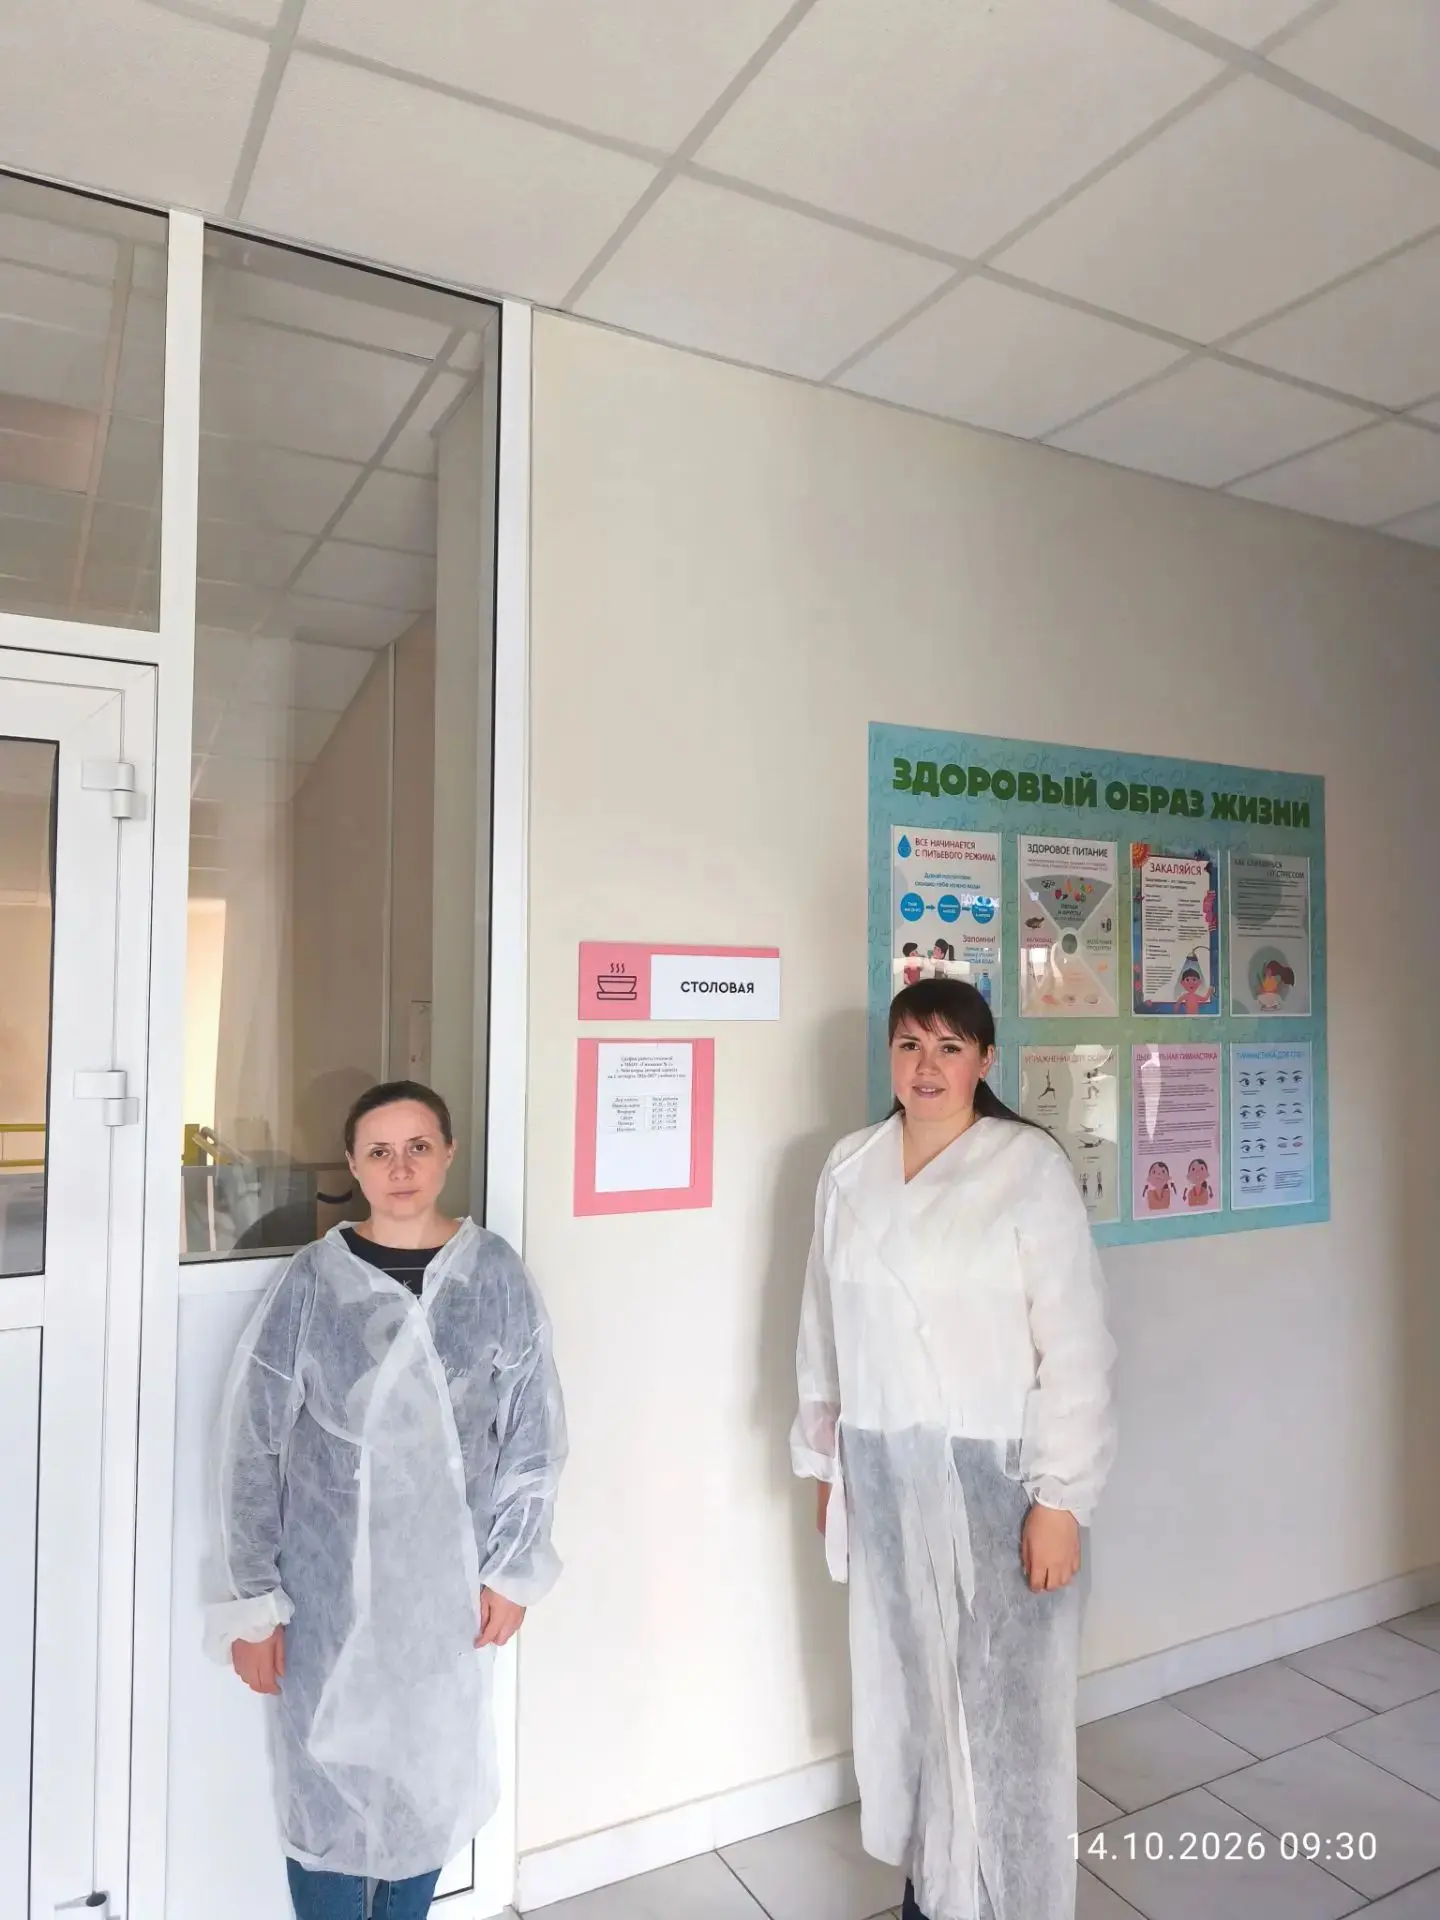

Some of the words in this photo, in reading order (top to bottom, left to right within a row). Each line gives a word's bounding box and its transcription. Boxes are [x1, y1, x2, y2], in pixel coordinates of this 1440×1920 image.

[893, 757, 1098, 808] ЗДОРОВЫЙ
[1104, 781, 1204, 818] ОБРАЗ
[1210, 792, 1310, 828] ЖИЗНИ
[915, 837, 929, 847] ВСЕ
[930, 839, 976, 850] НАЧИНАЕТСЯ
[1027, 843, 1071, 856] ЗДОРОВОЕ
[1072, 846, 1108, 858] ПИТАНИЕ
[915, 849, 921, 857] С
[922, 849, 963, 860] ПИТЬЕВОГО
[965, 852, 996, 862] РЕЖИМА
[1150, 862, 1202, 876] ЗАКАЛЯЙСЯ
[680, 980, 755, 994] СТОЛОВАЯ
